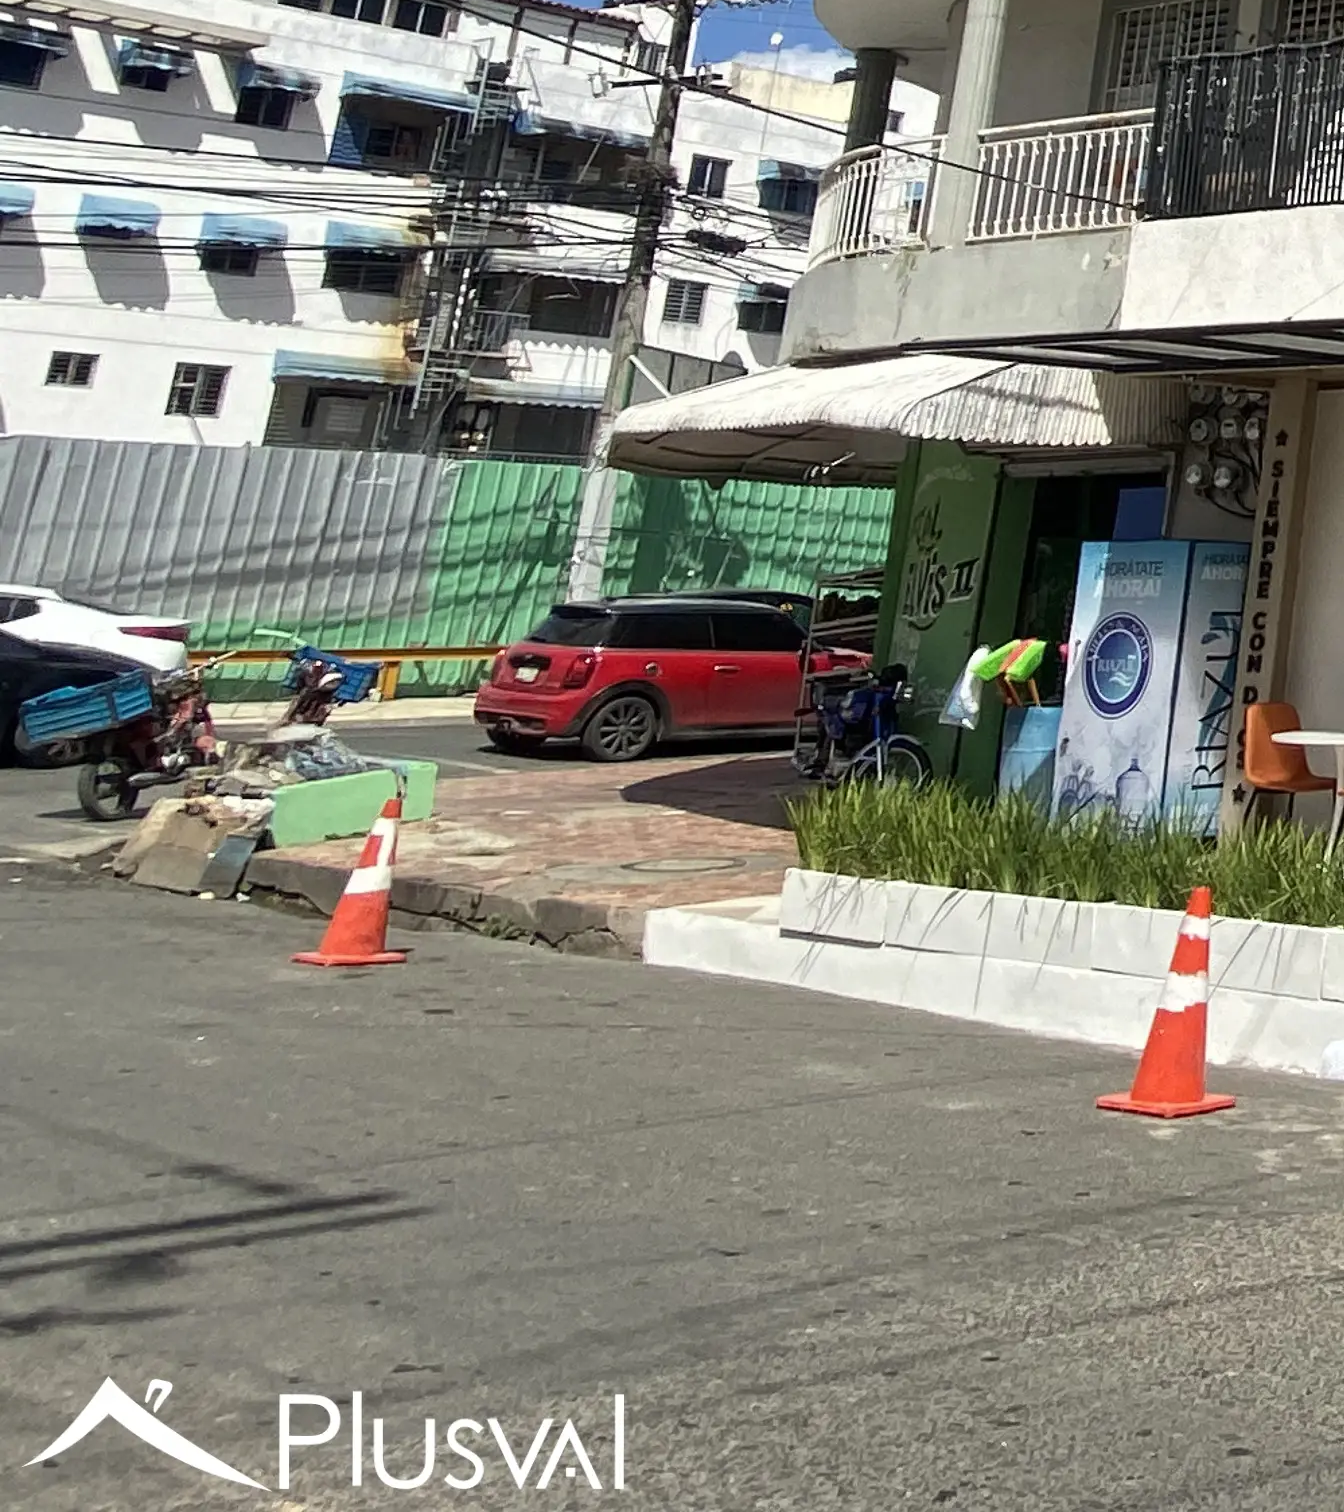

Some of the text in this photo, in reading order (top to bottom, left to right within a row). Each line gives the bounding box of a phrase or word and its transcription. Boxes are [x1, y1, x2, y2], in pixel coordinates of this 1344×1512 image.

[1256, 459, 1284, 600] SIEMPRE
[1200, 565, 1244, 580] AHOR
[1246, 610, 1268, 674] CON
